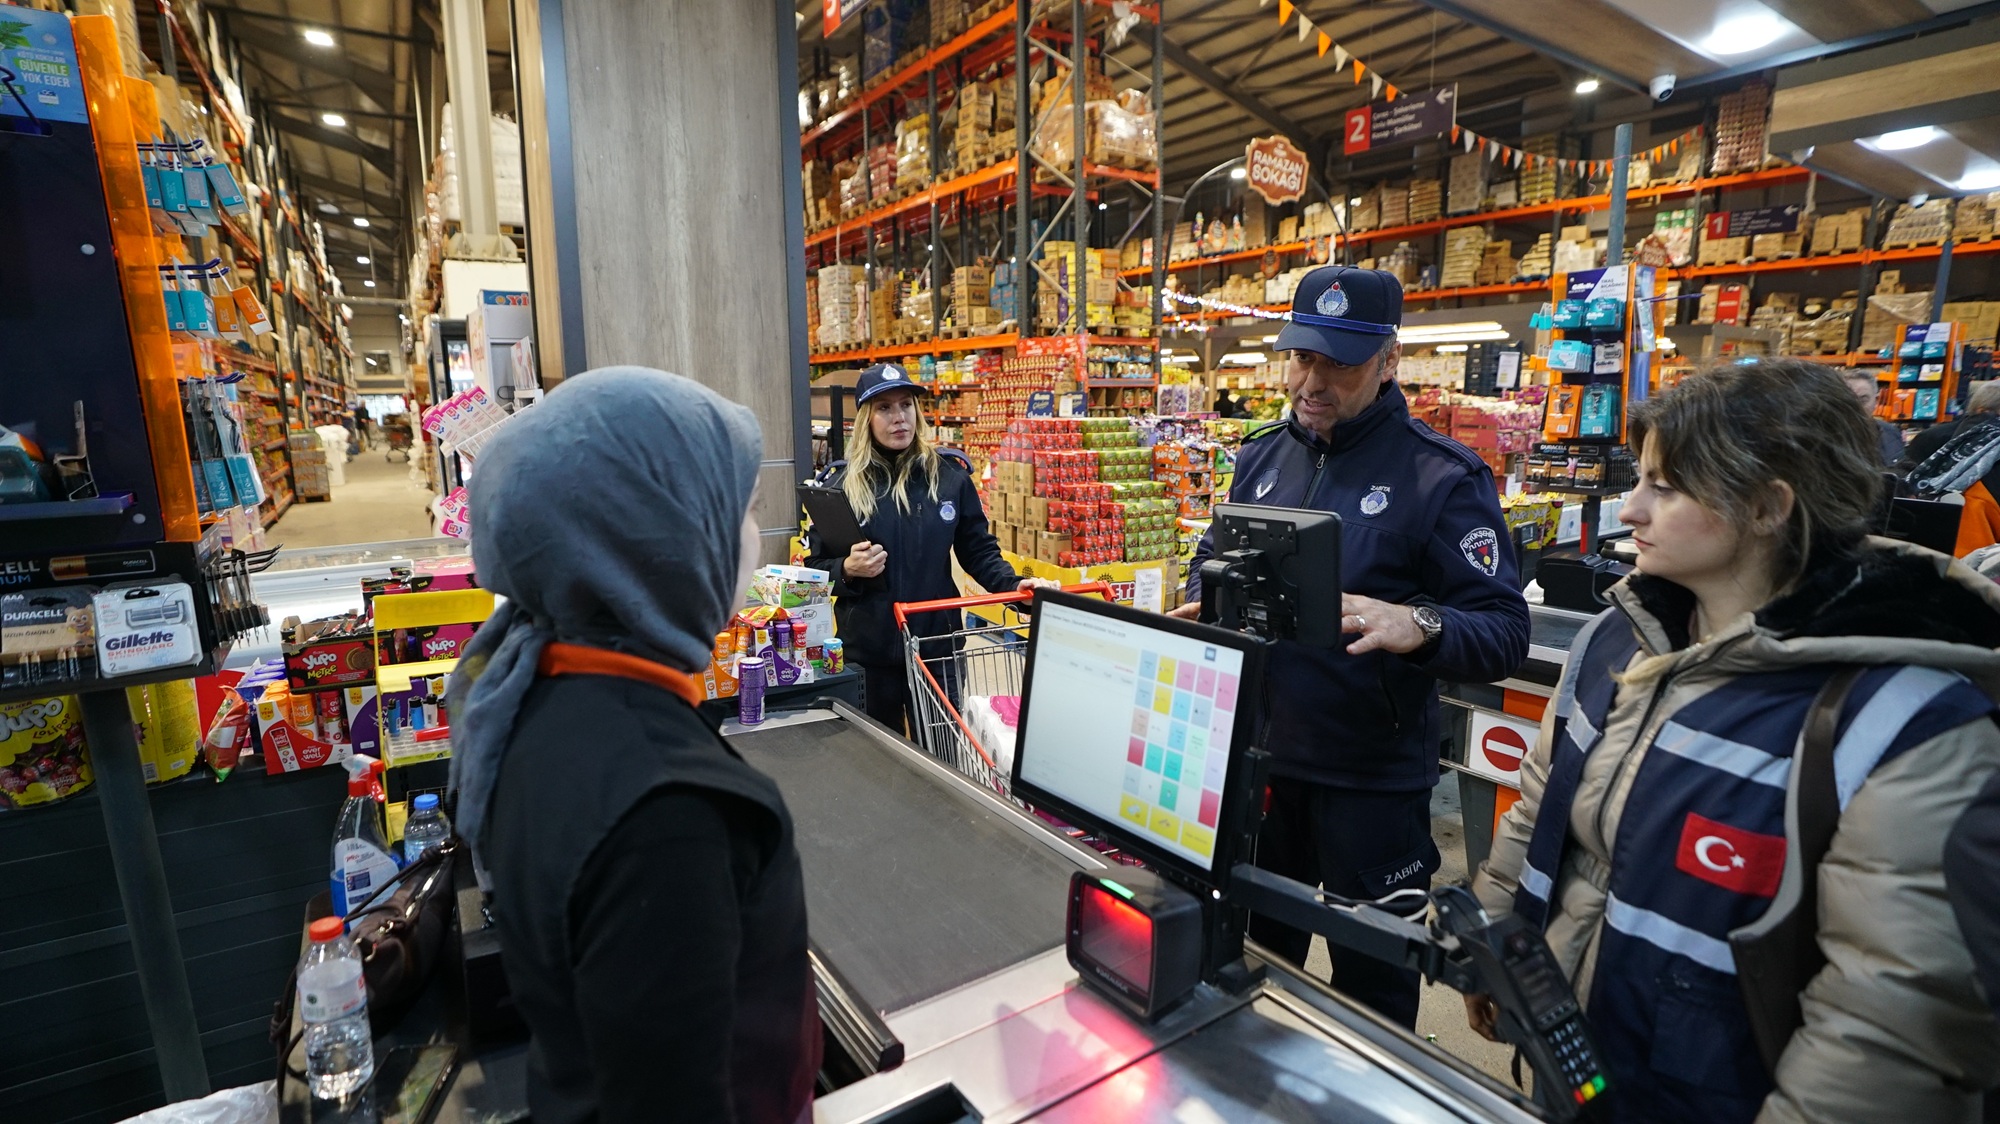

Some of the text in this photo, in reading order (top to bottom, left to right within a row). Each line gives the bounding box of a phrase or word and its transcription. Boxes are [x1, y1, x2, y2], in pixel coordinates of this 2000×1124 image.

[19, 59, 68, 76] GÜVENLE
[21, 72, 70, 88] YOK EDER
[1349, 114, 1366, 143] 2
[1253, 149, 1304, 176] RAMAZAN
[1711, 215, 1724, 235] 1
[1370, 485, 1391, 493] ZABITA
[3, 593, 25, 601] AAA
[3, 608, 64, 621] DURACELL
[105, 630, 174, 650] Gillette
[425, 640, 456, 655] Yupo
[107, 642, 175, 657] SKINGUARD
[109, 662, 118, 672] 2
[302, 653, 337, 670] Yupo
[302, 746, 322, 755] ever
[302, 752, 326, 761] well
[1383, 859, 1424, 886] ZABITA
